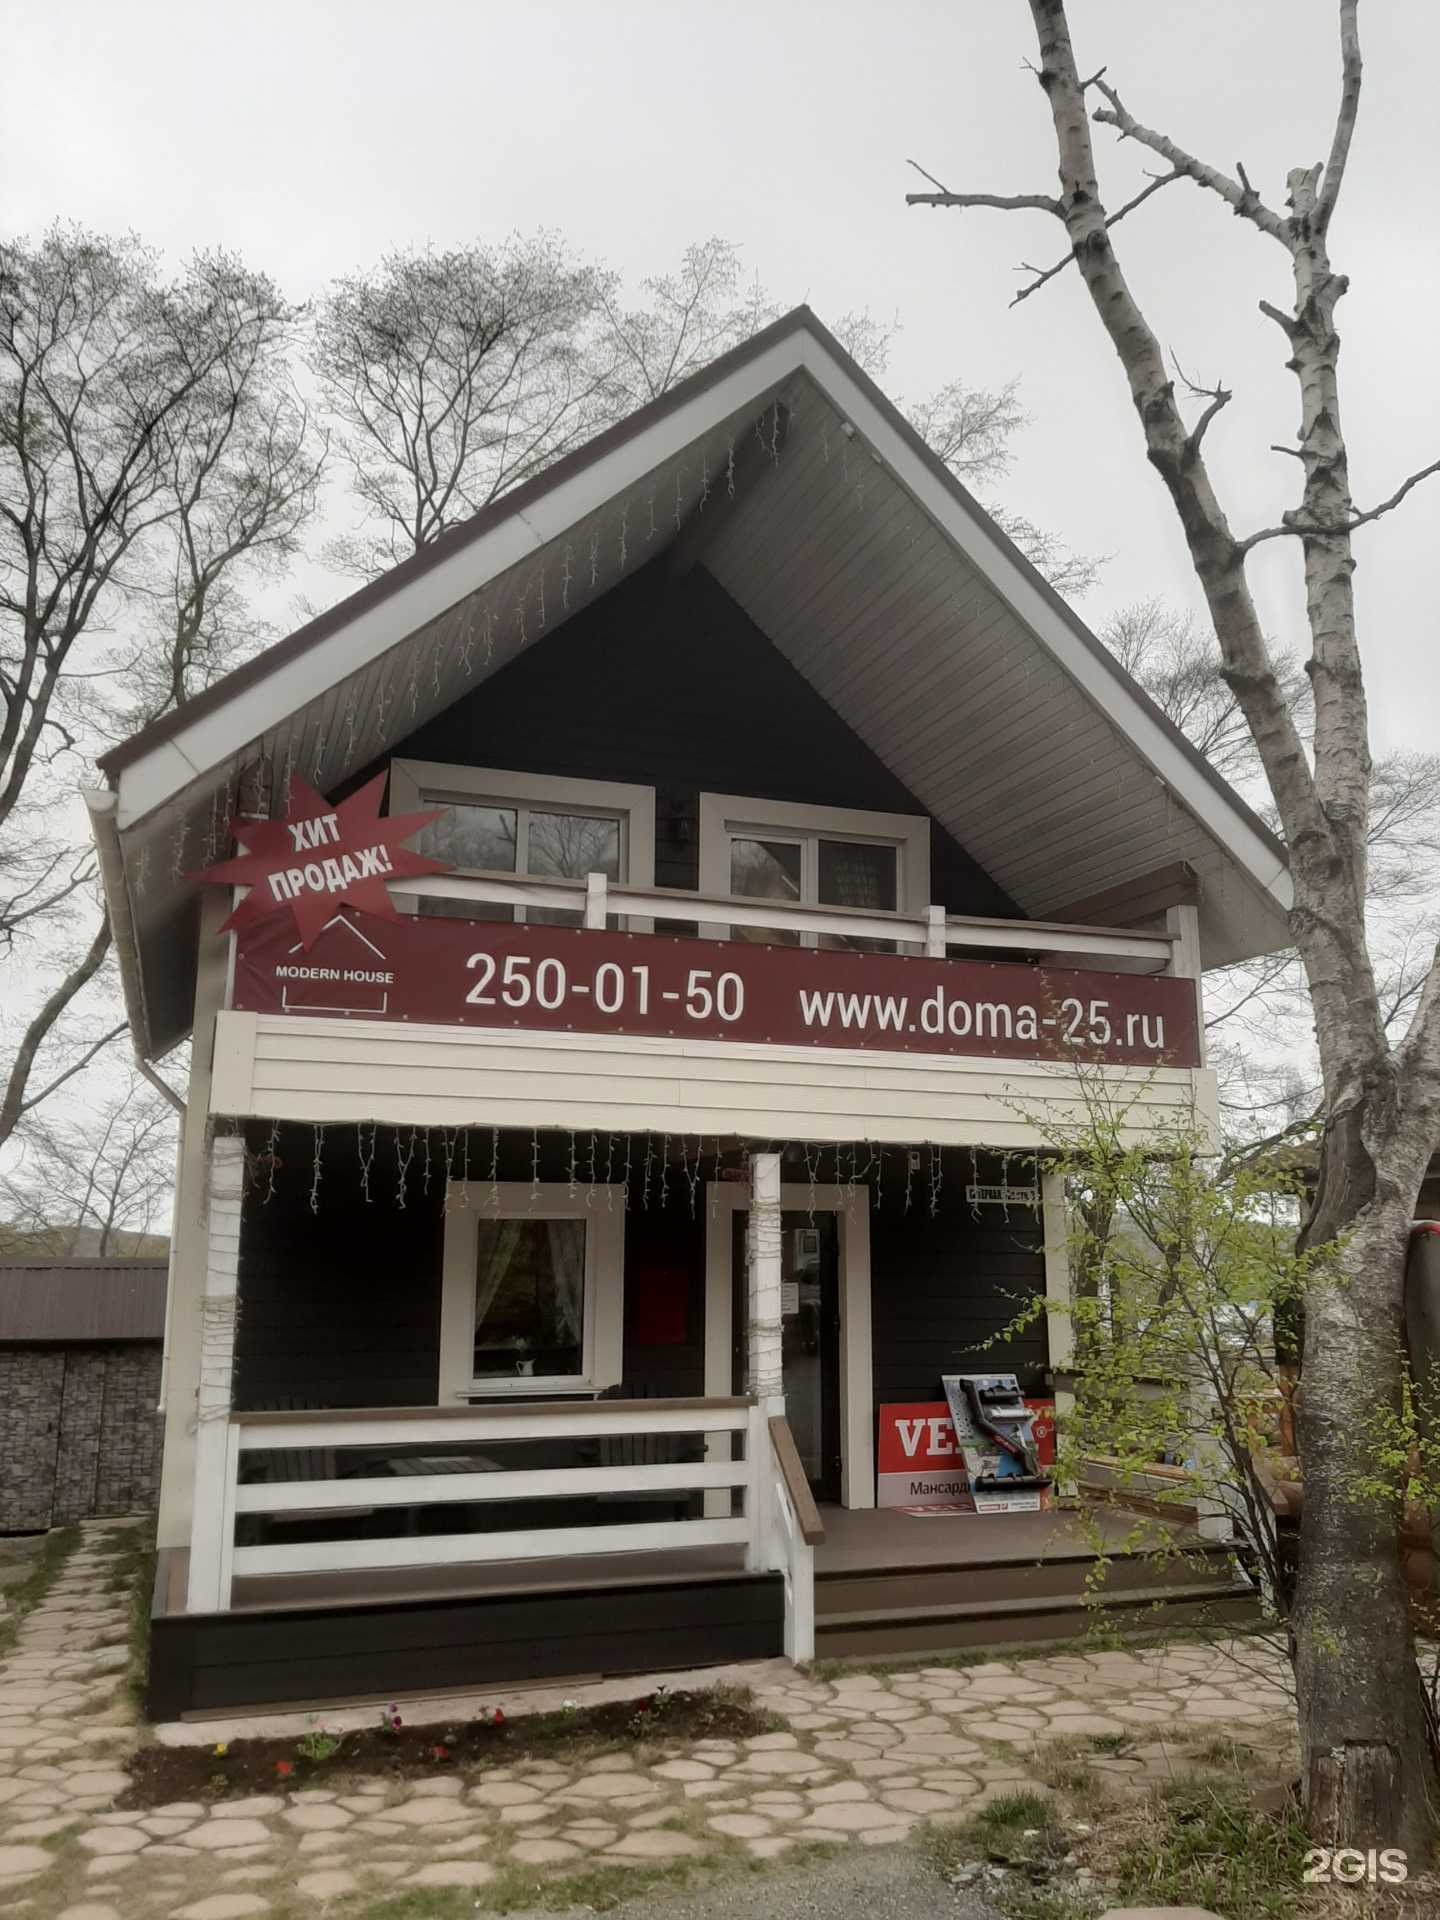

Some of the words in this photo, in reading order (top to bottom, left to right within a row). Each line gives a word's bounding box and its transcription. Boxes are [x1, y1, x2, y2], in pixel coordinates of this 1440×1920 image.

[287, 813, 341, 852] ХИТ
[267, 844, 393, 902] ПРОДАЖ!
[275, 965, 341, 981] MODERN
[343, 969, 395, 984] HOUSE
[464, 952, 745, 1022] 250-01-50
[798, 984, 1166, 1049] www.doma-25.ru
[910, 1480, 970, 1498] Мансард
